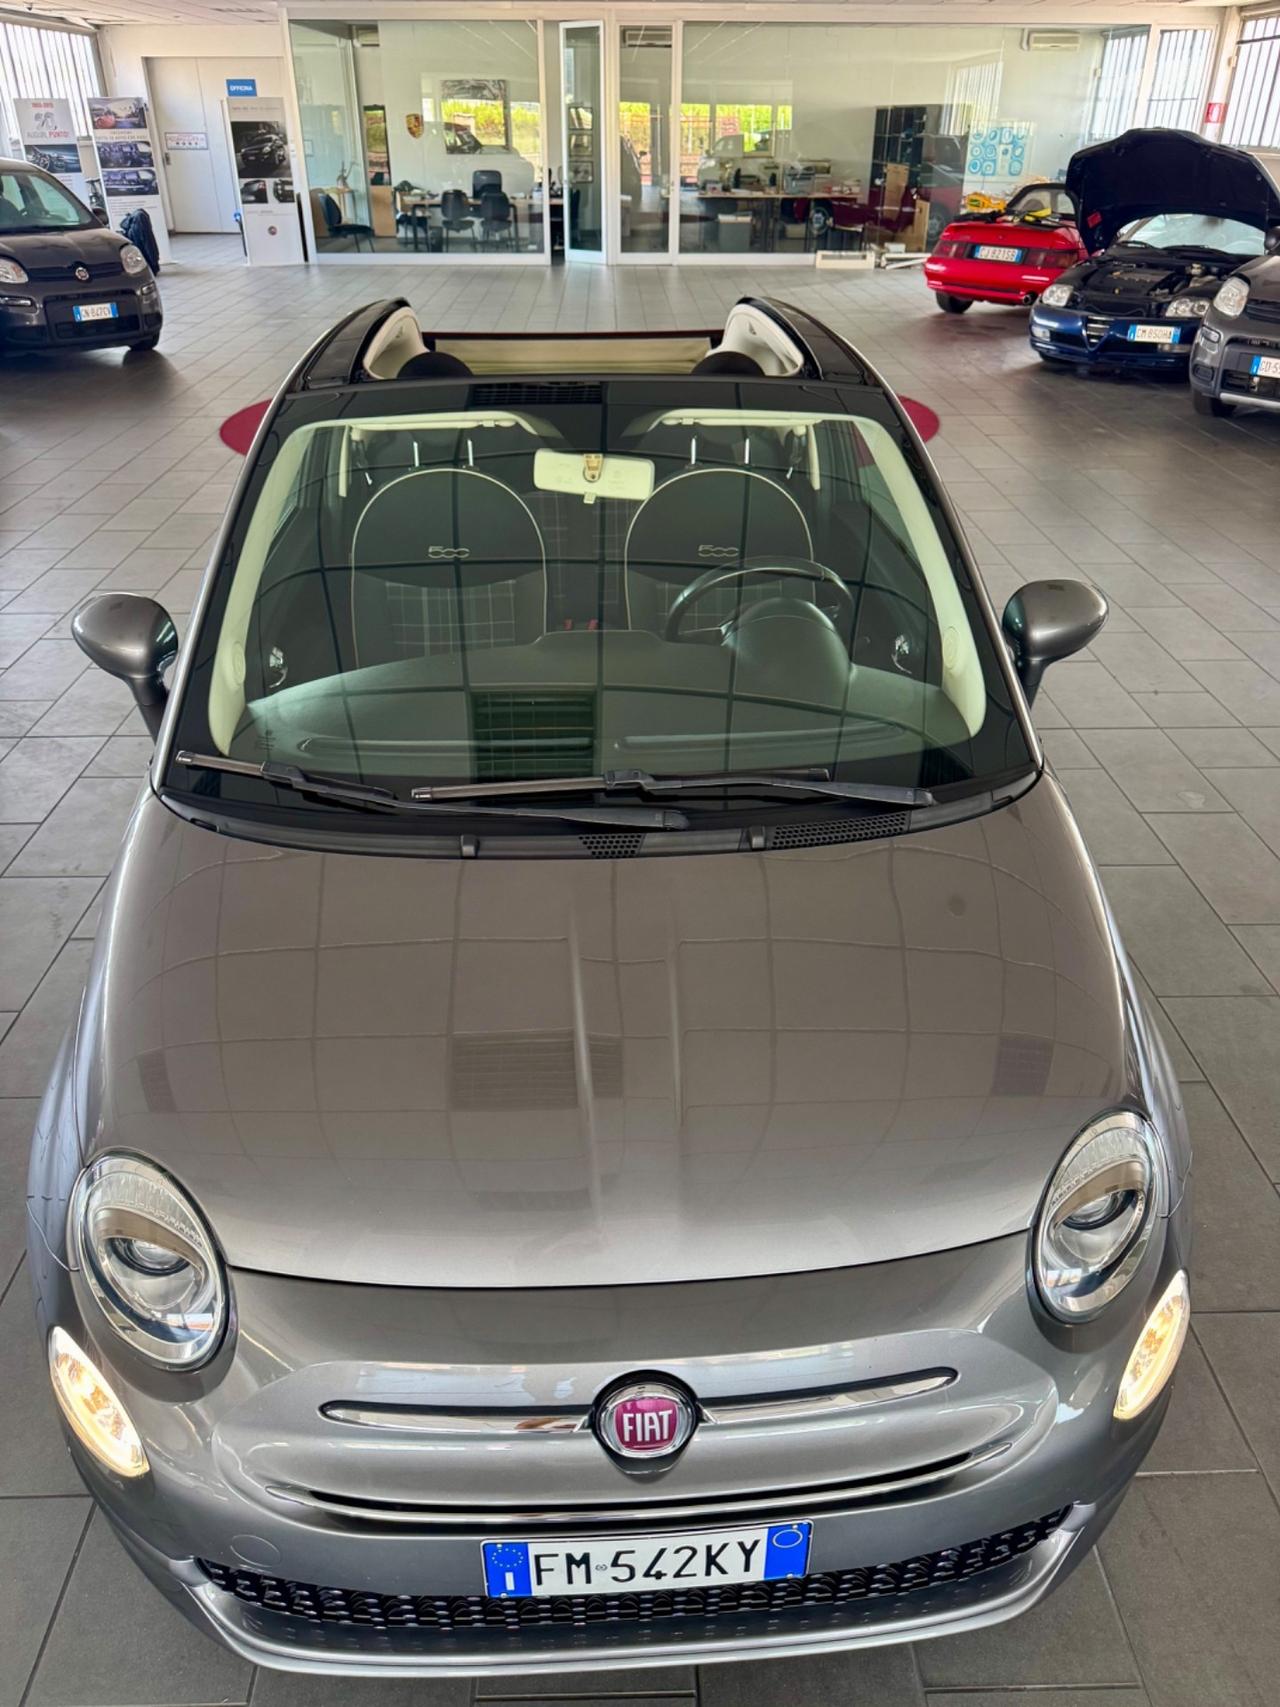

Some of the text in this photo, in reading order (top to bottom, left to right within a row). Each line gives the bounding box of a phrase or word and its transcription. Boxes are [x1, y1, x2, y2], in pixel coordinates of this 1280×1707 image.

[428, 545, 470, 559] 500
[698, 544, 739, 558] 500
[622, 1409, 674, 1442] FIAT
[533, 1552, 592, 1586] FM
[610, 1538, 761, 1584] 542KY
